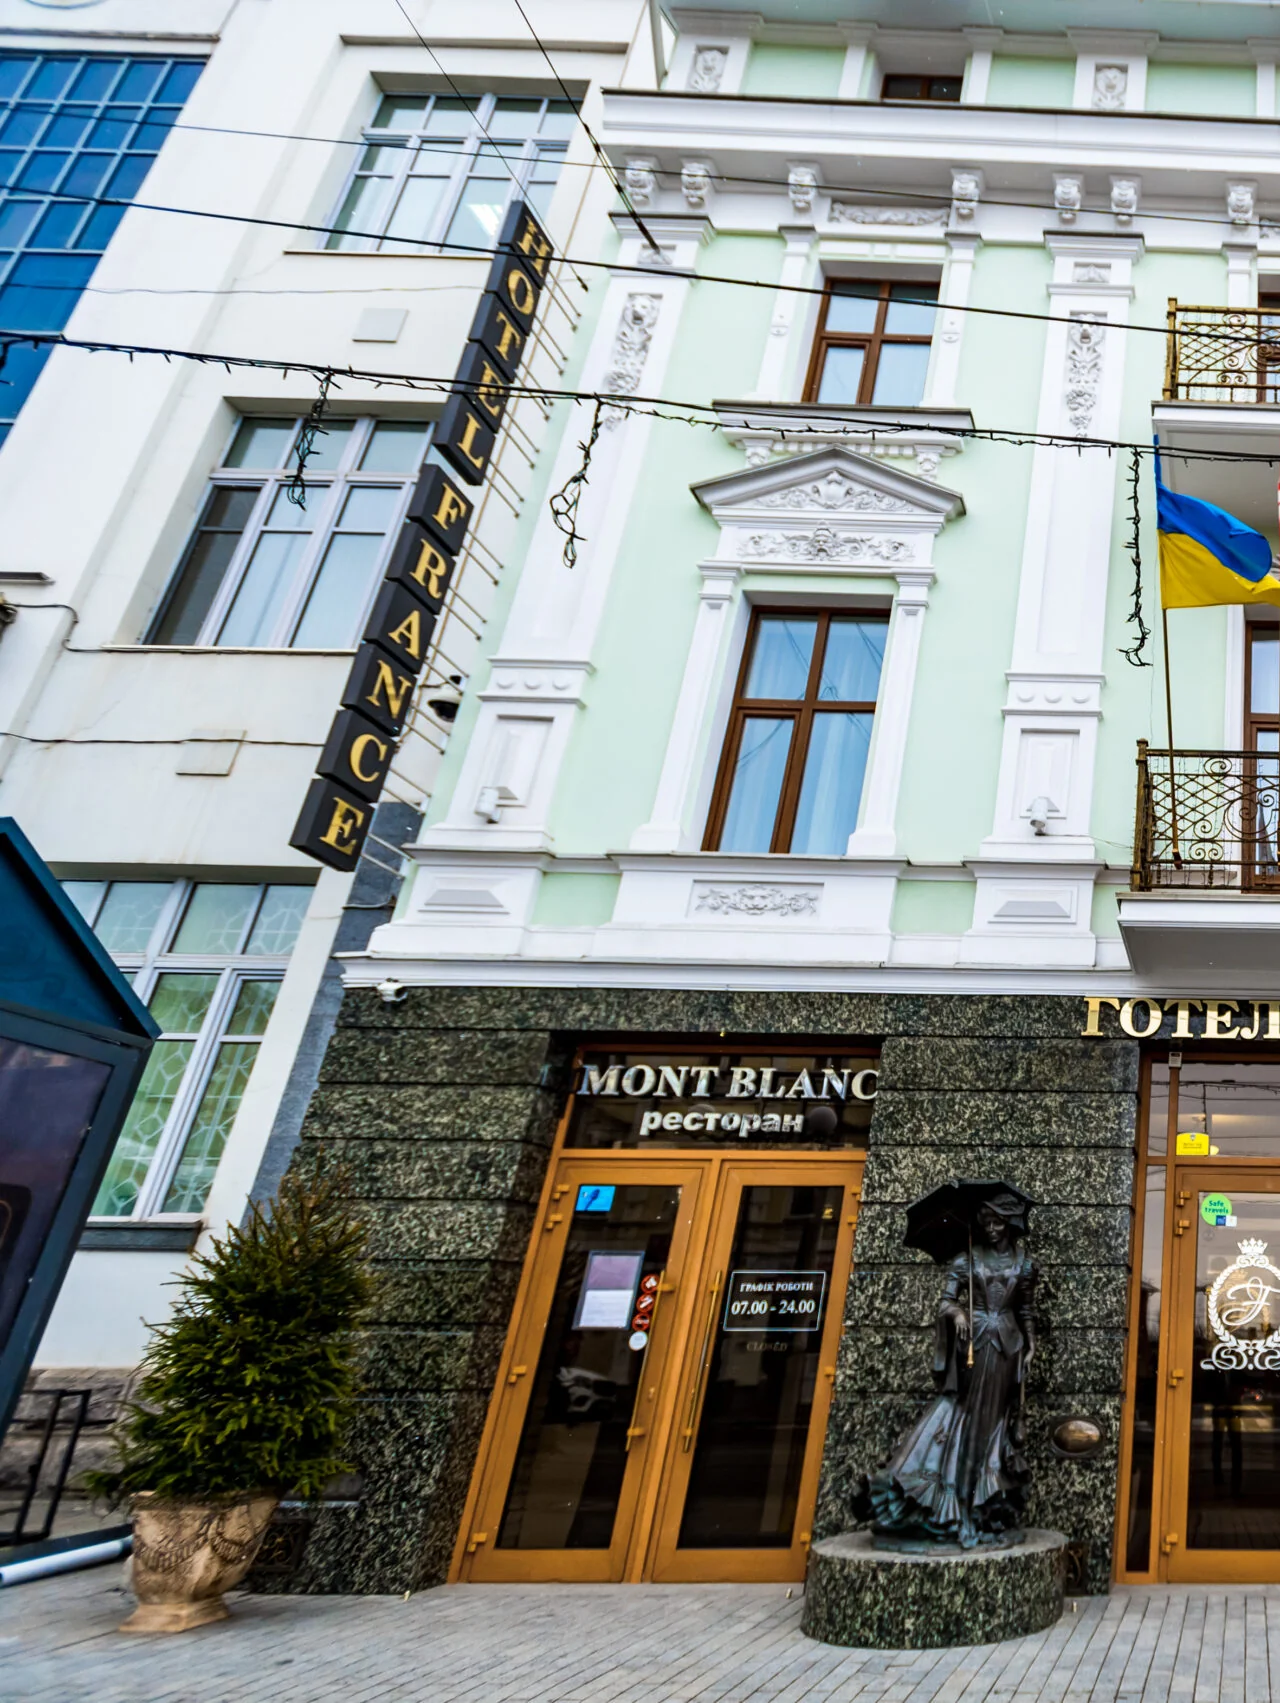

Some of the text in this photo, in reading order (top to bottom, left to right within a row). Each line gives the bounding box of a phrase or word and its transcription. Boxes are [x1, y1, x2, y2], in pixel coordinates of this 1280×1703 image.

[320, 215, 551, 855] HOTEL FRANCE
[577, 1064, 880, 1100] MONT BLANC
[640, 1111, 804, 1138] ресторан
[740, 1282, 814, 1292] ГРАФІК РОБОТИ
[731, 1300, 768, 1315] 07.00
[778, 1300, 815, 1314] 24.00
